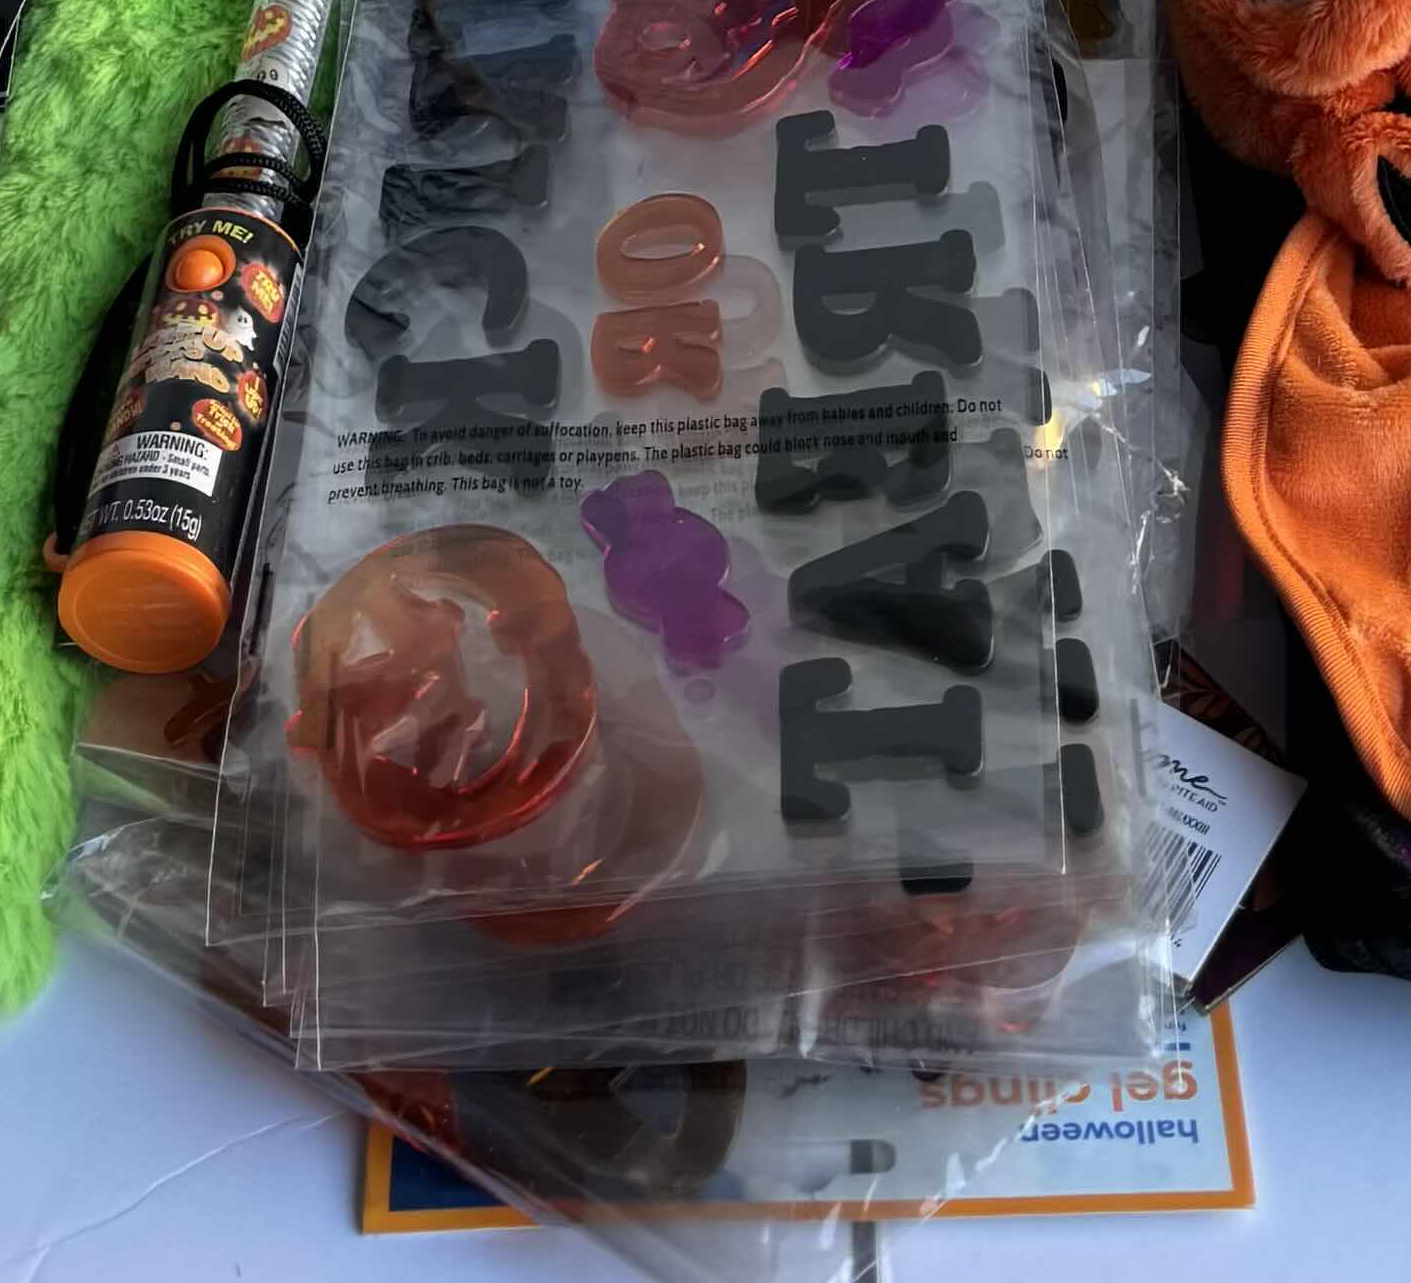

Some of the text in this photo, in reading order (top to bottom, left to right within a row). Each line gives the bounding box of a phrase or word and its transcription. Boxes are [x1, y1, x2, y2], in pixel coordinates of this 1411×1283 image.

[168, 219, 254, 244] TRY ME!
[616, 398, 1003, 438] keep this plastic bag babies and Do not
[137, 431, 209, 462] WARNING:
[333, 439, 782, 475] use this or playpens. The plastic bag could
[1025, 445, 1069, 460] Do not
[328, 475, 507, 505] prevent This bag
[123, 498, 202, 541] 0.53oz (15g)
[1109, 1060, 1199, 1113] gel
[1021, 1119, 1200, 1145] halloween
